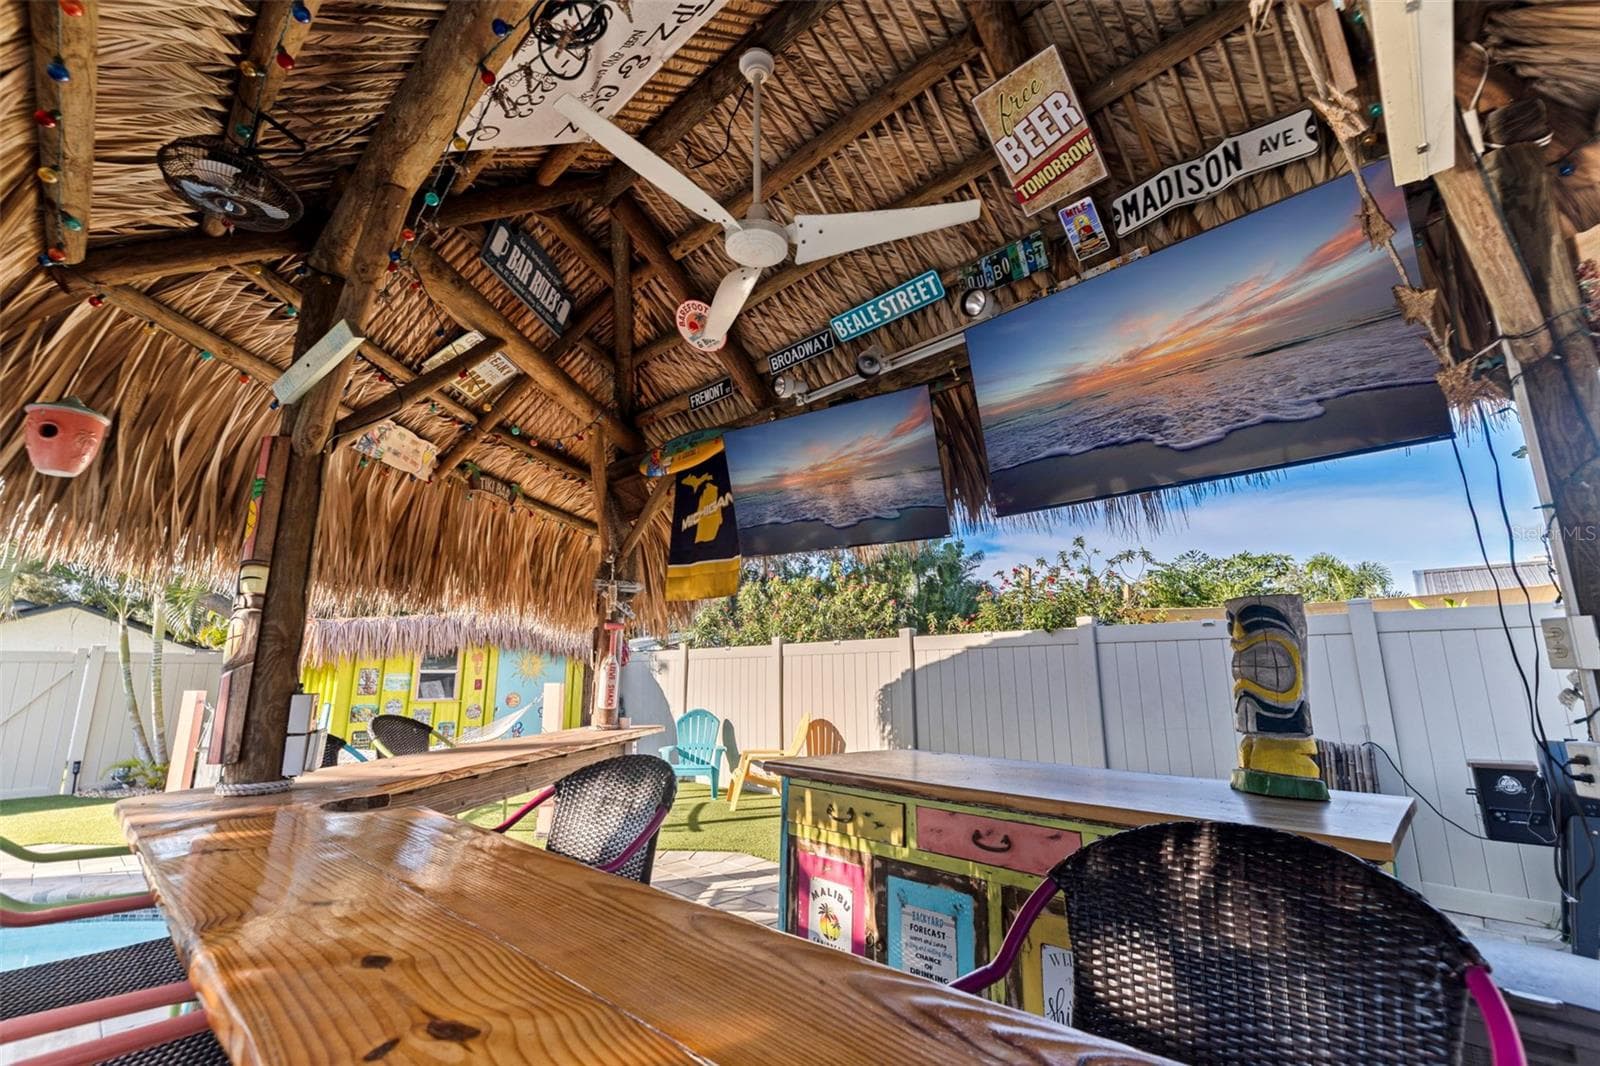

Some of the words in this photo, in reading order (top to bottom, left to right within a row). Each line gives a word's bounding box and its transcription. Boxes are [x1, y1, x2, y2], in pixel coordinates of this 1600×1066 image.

[618, 54, 653, 79] &
[999, 79, 1042, 138] free
[995, 89, 1083, 174] BEER
[1016, 133, 1096, 200] TOMORROW
[1121, 141, 1243, 228] MADISON
[1258, 128, 1304, 157] AVE.
[1064, 202, 1088, 219] MILE
[506, 244, 534, 286] BAR
[529, 269, 562, 314] RULES
[833, 304, 880, 339] BEALE
[881, 275, 940, 319] STREET
[770, 331, 831, 371] BROADWAY
[690, 383, 724, 408] FREMONT
[480, 477, 496, 495] TIKI
[811, 887, 851, 912] MALIBU
[909, 923, 946, 940] FORECAST
[915, 952, 942, 966] CHANCE
[924, 963, 933, 971] OF
[909, 966, 949, 985] DRINKING
